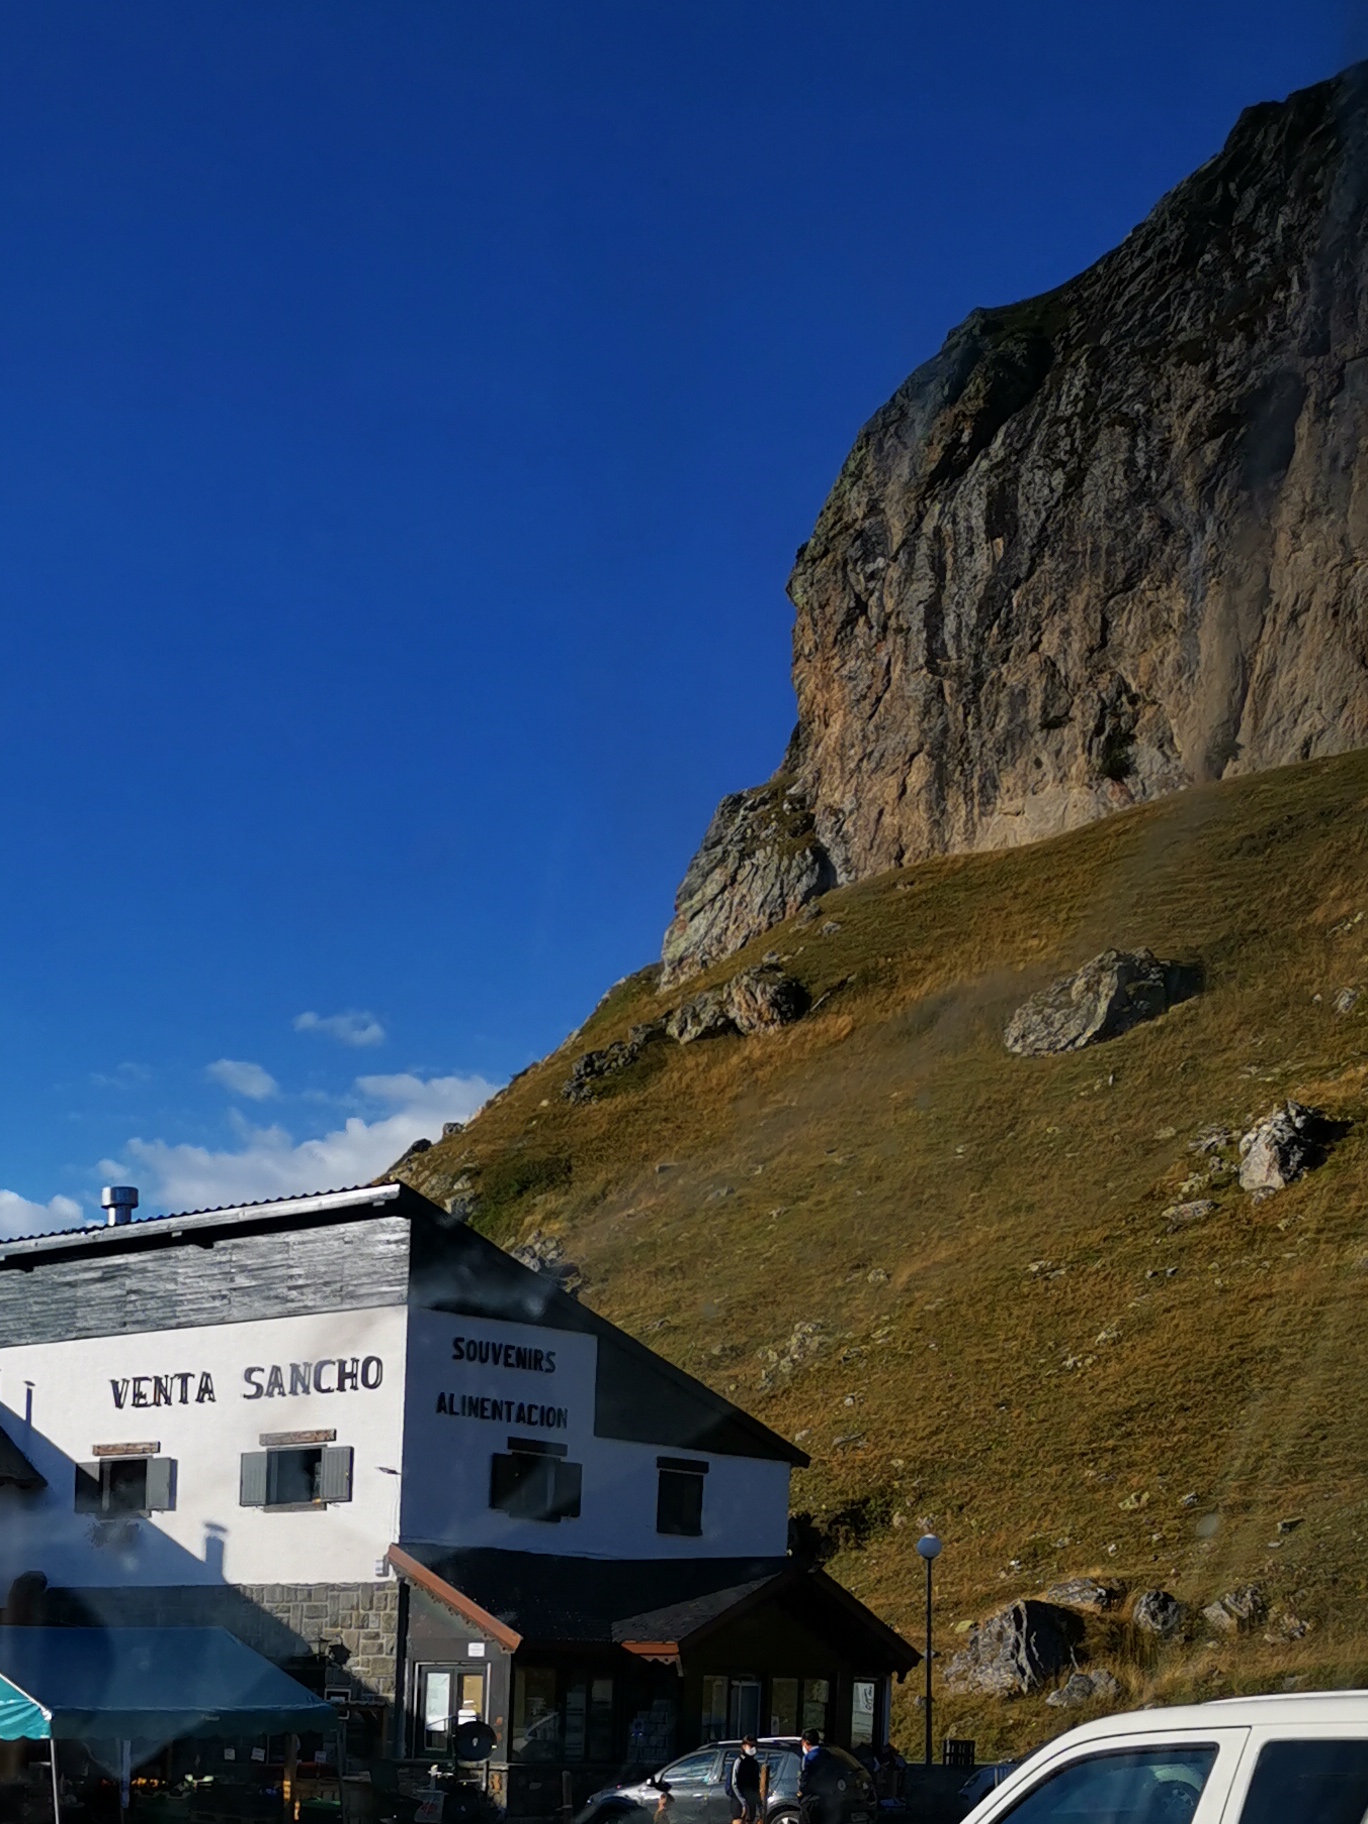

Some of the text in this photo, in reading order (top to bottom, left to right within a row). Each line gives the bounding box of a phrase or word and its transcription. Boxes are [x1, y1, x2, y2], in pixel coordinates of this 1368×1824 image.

[451, 1336, 556, 1374] SOUVENIRS
[109, 1355, 384, 1410] VENTA SANCHO
[435, 1391, 569, 1430] ALIMENTACION
